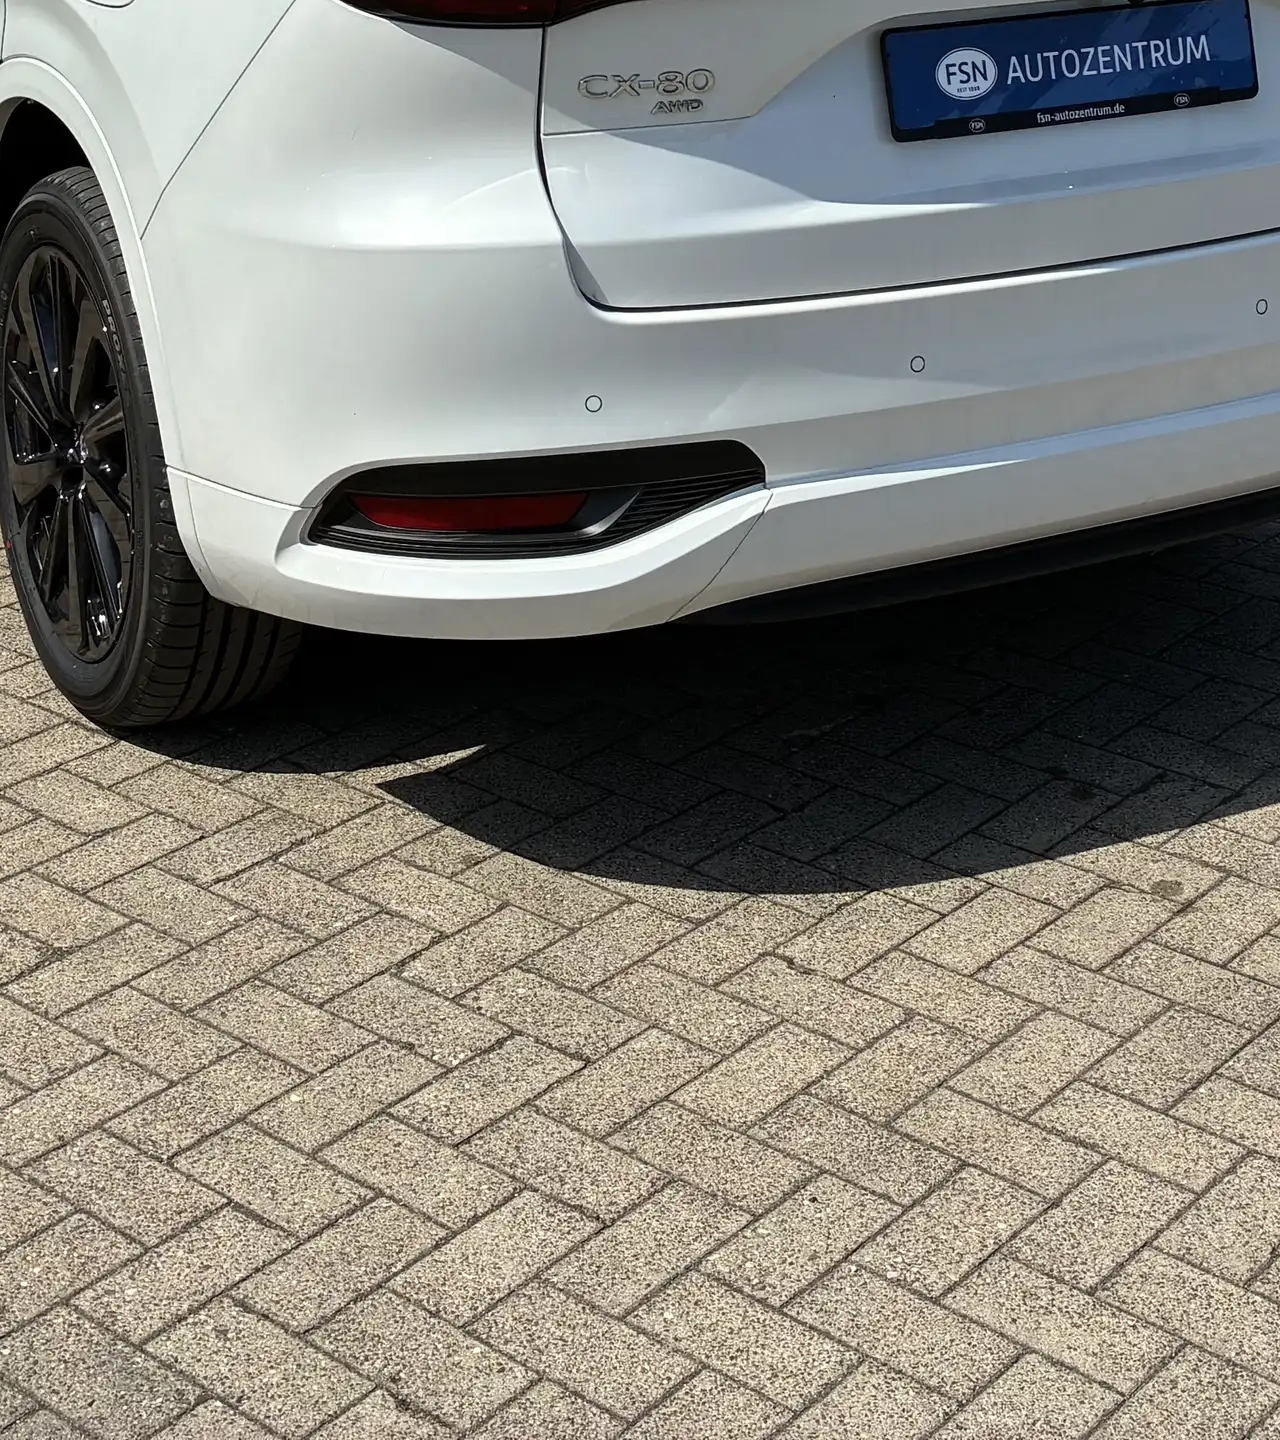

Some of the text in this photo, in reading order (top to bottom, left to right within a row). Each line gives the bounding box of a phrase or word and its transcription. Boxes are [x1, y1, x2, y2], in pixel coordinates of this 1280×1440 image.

[944, 34, 1211, 86] FSN AUTOZENTRUM
[577, 68, 716, 99] CX-80
[650, 99, 704, 116] AWD
[1036, 102, 1126, 124] fsn-autozentrum.de
